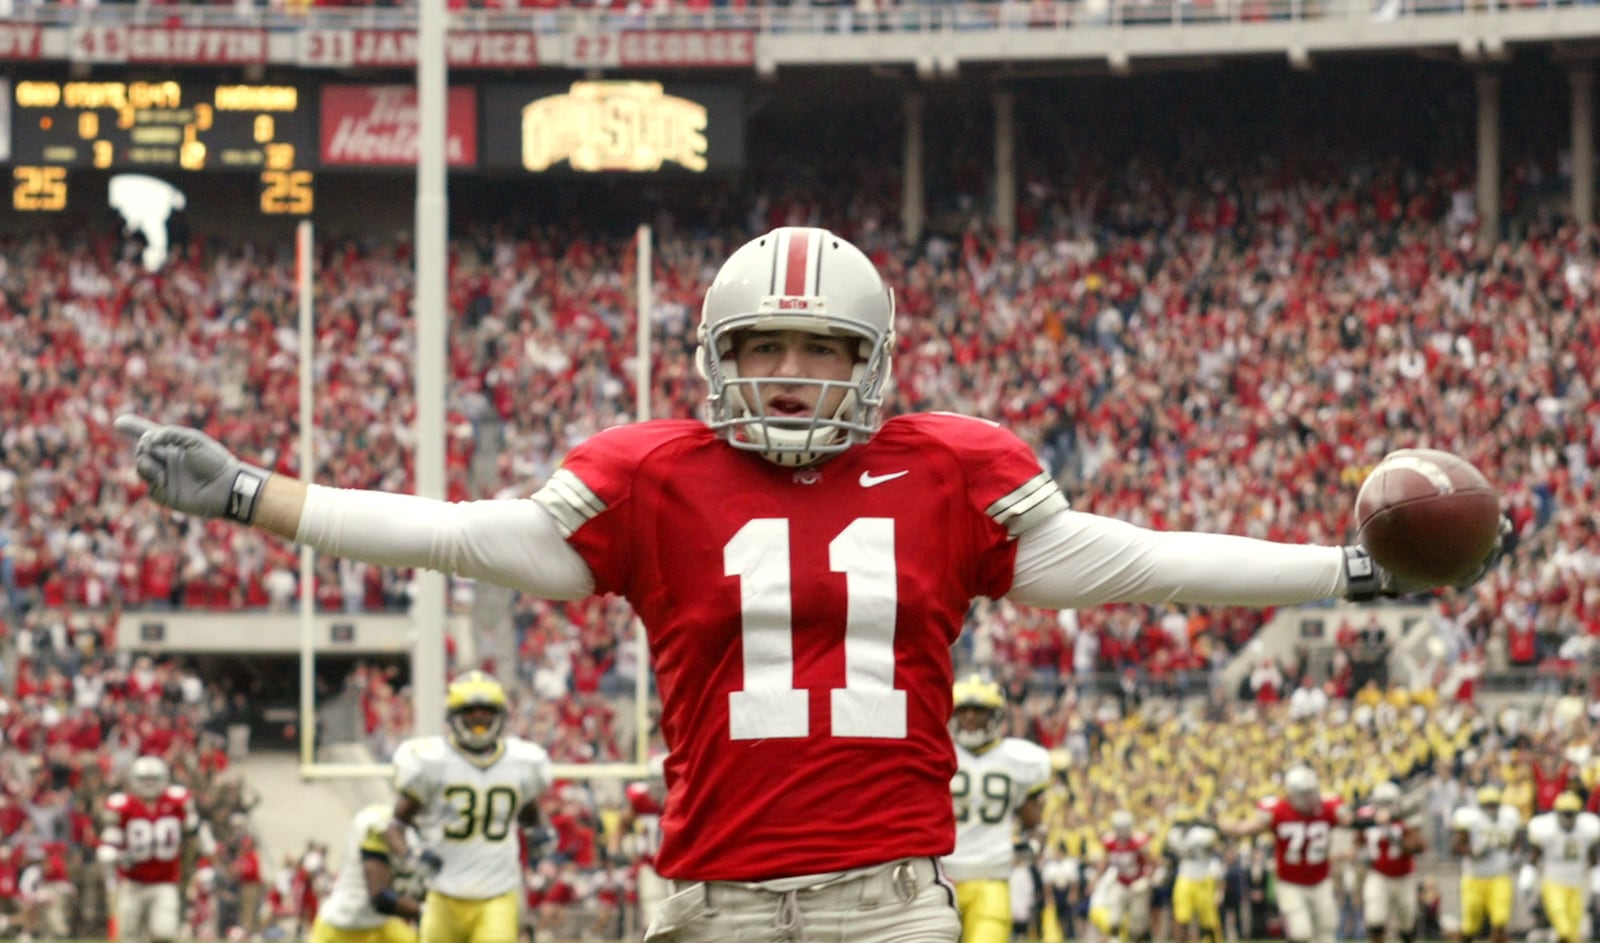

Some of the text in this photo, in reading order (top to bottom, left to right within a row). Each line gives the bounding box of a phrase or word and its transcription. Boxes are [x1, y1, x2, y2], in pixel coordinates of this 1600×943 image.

[129, 29, 265, 60] GRIFFIN
[355, 32, 535, 64] JANWICZ
[624, 31, 752, 63] GEORGE
[14, 166, 67, 211] 25
[261, 170, 314, 214] 25
[723, 516, 908, 741] 11
[444, 784, 517, 842] 30
[1277, 821, 1331, 866] 72
